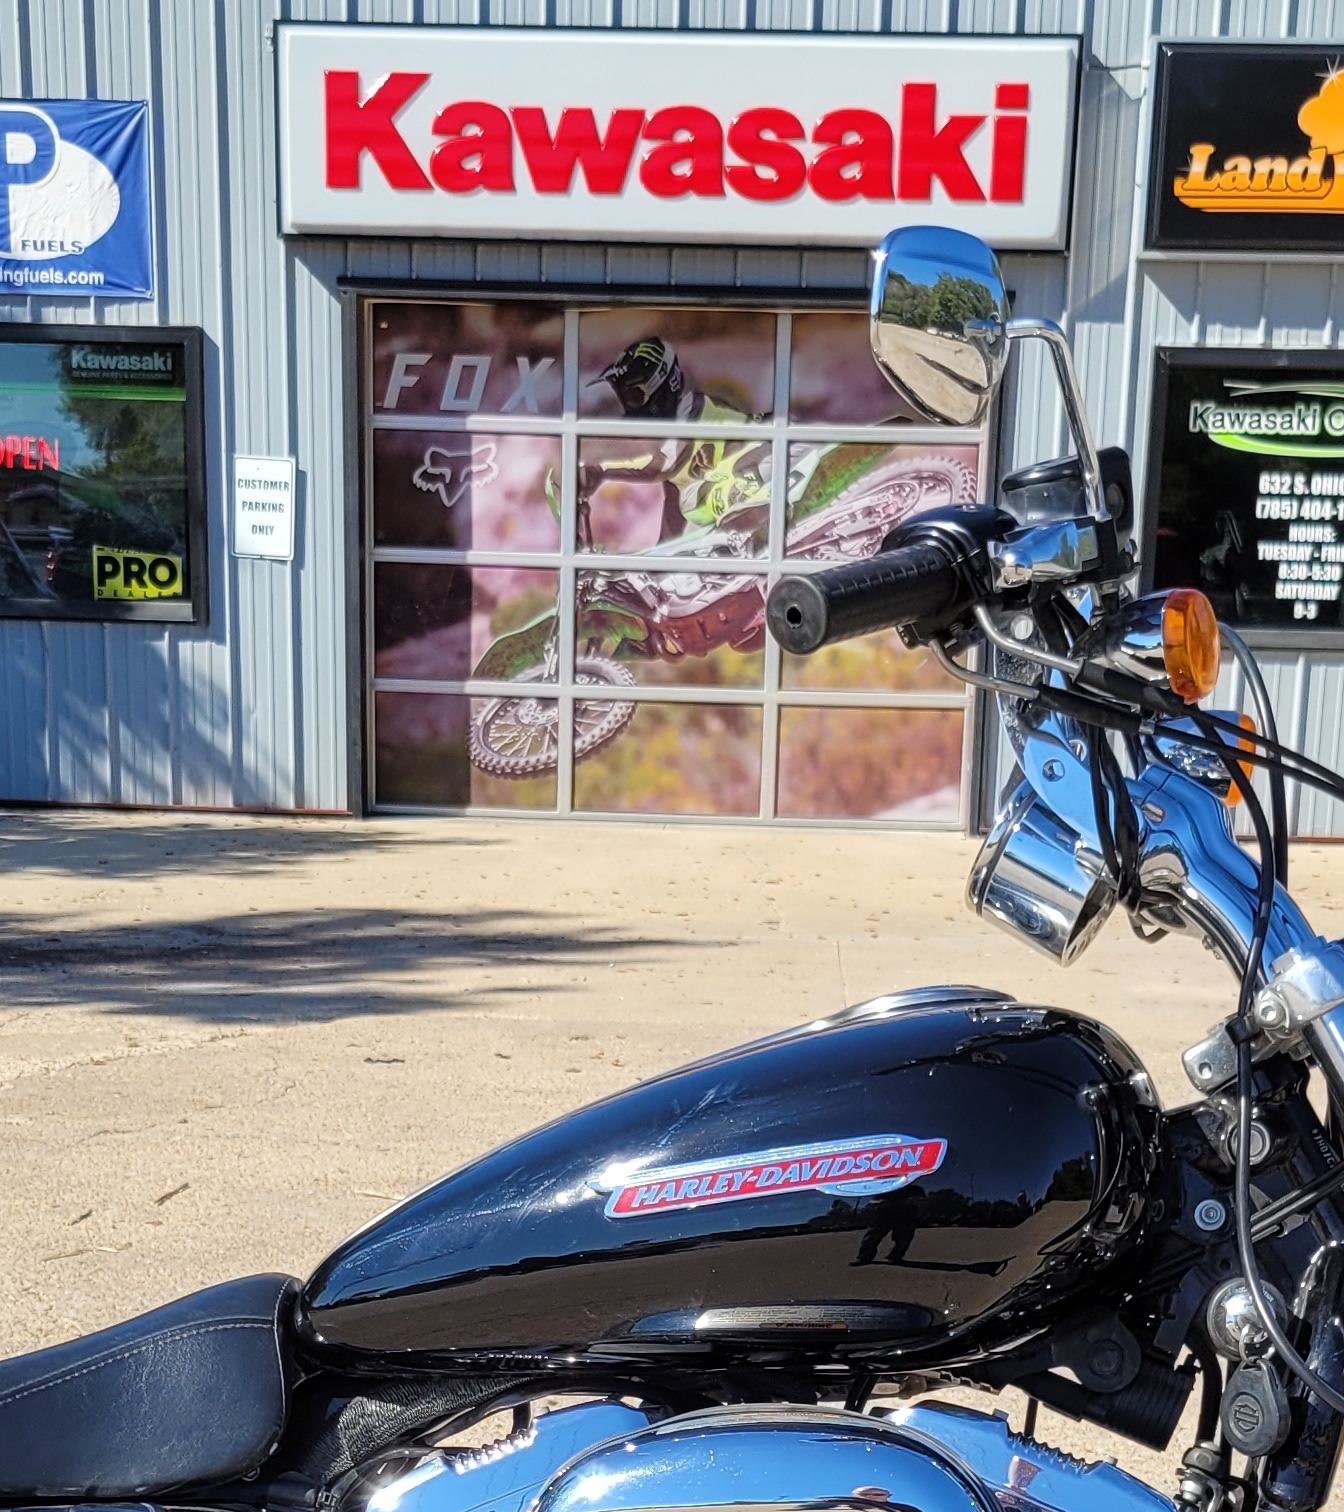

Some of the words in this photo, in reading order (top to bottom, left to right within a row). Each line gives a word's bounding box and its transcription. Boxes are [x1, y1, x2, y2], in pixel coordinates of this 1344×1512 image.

[323, 68, 1032, 205] Kawasaki
[1182, 143, 1327, 193] Land
[21, 239, 84, 253] FUELS
[71, 349, 172, 371] Kawasaki
[382, 353, 556, 413] FOX
[1190, 402, 1318, 433] Kawasaki
[237, 478, 290, 491] CUSTOMER
[1259, 472, 1292, 495] 632
[241, 501, 285, 513] PARKING
[1256, 497, 1298, 519] (785)
[251, 524, 275, 536] ONLY
[1288, 523, 1338, 542] HOURS:
[1257, 541, 1312, 560] TUESDAY
[97, 555, 178, 590] PRO
[1275, 581, 1341, 600] SATURDAY
[632, 1146, 924, 1209] HARLEY-DAVIDSON
